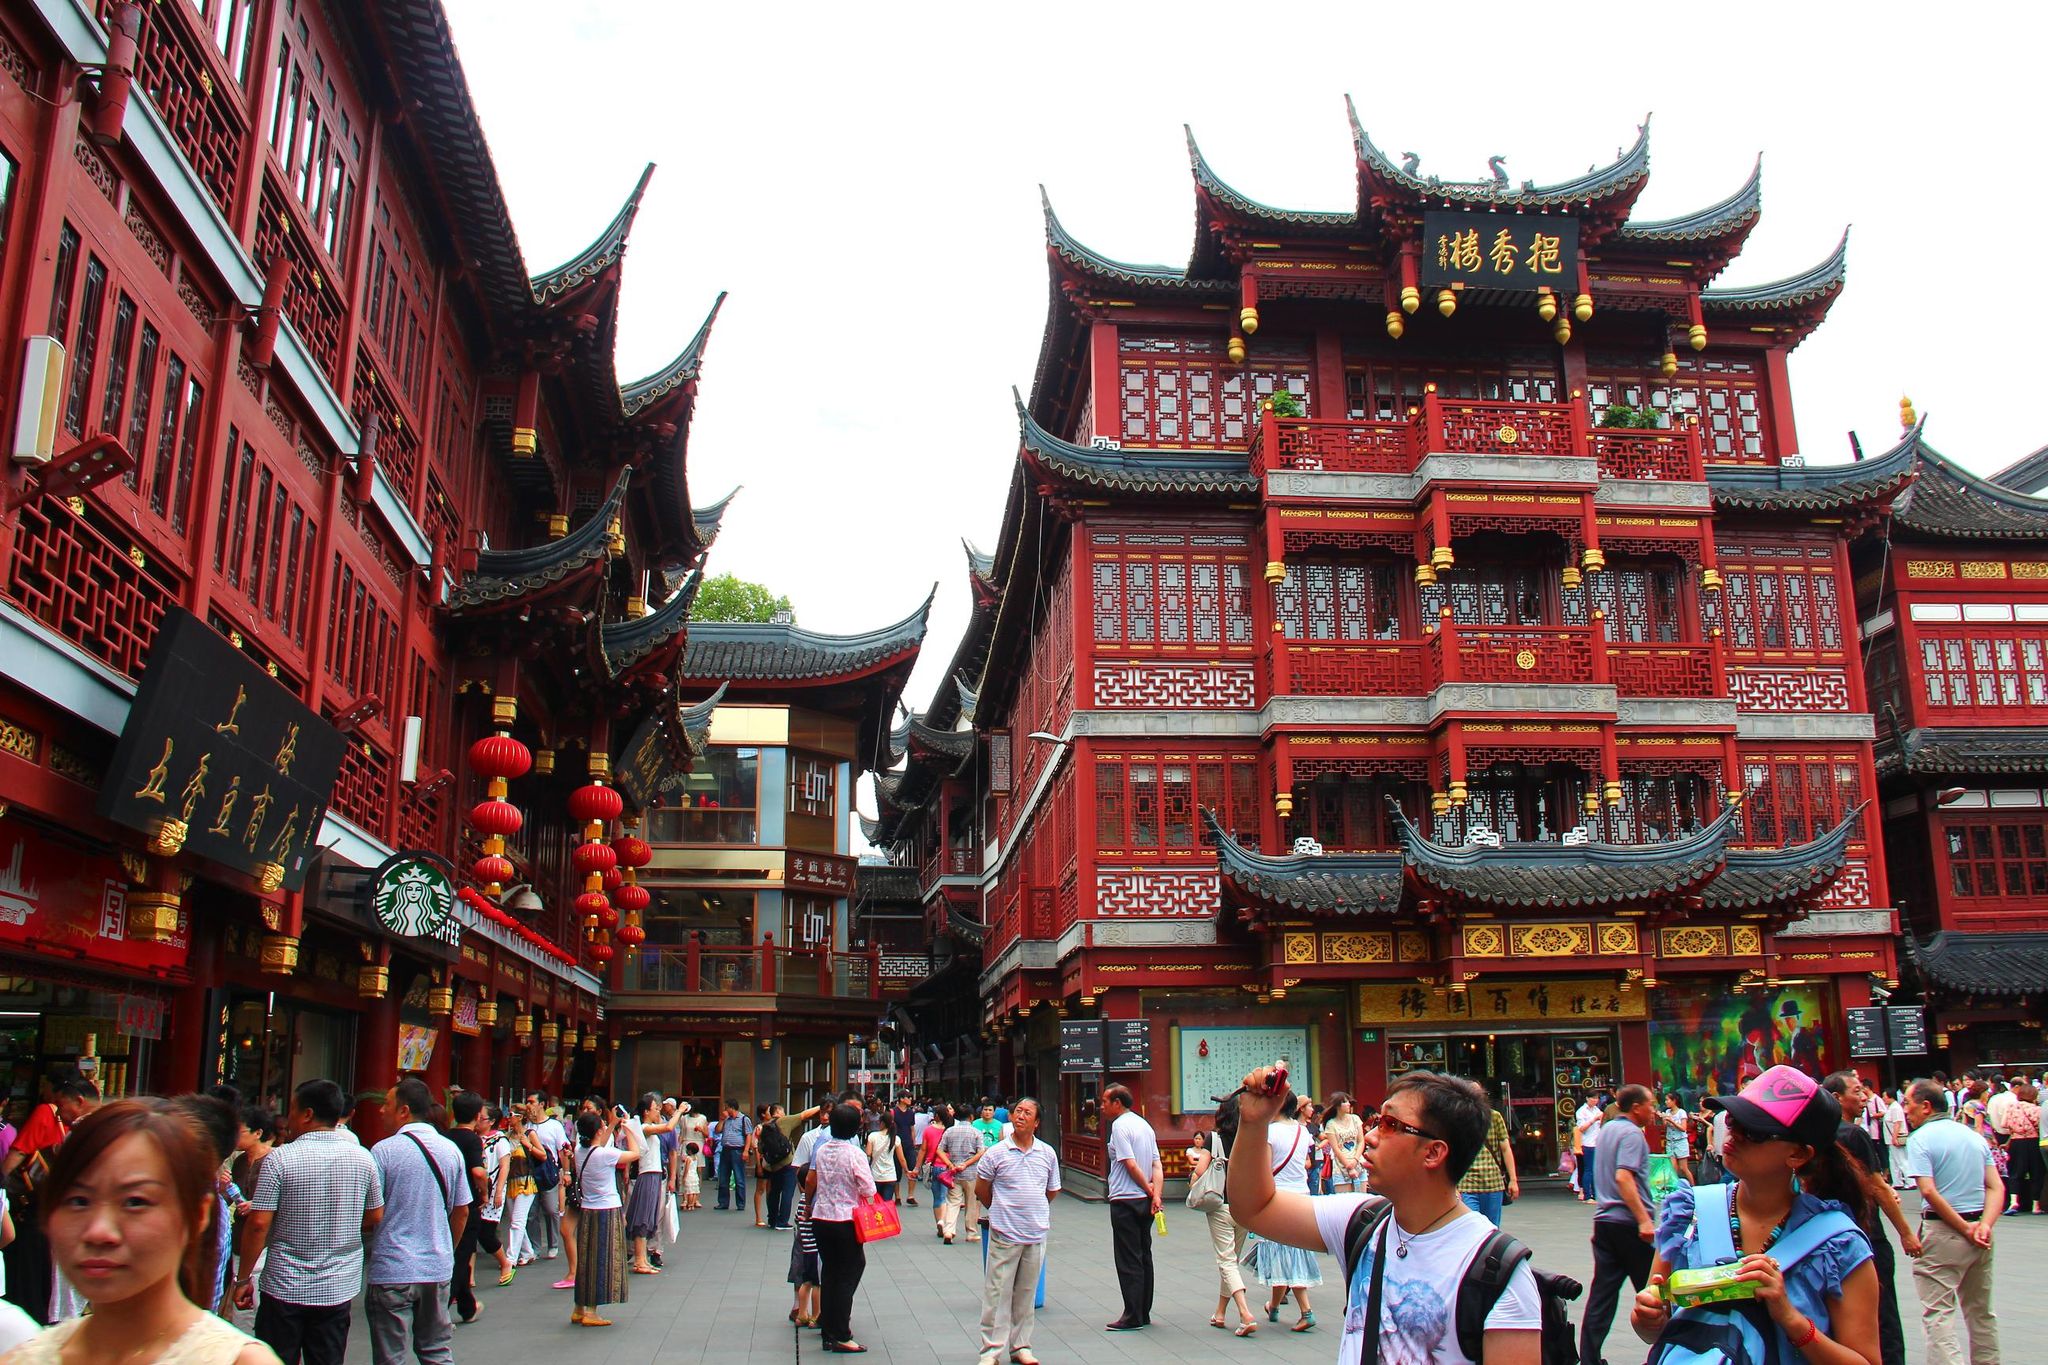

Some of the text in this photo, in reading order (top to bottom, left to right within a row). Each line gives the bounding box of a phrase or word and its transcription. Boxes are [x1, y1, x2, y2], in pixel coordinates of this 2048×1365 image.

[217, 684, 299, 776] 上海
[135, 737, 299, 864] 五香豆商店
